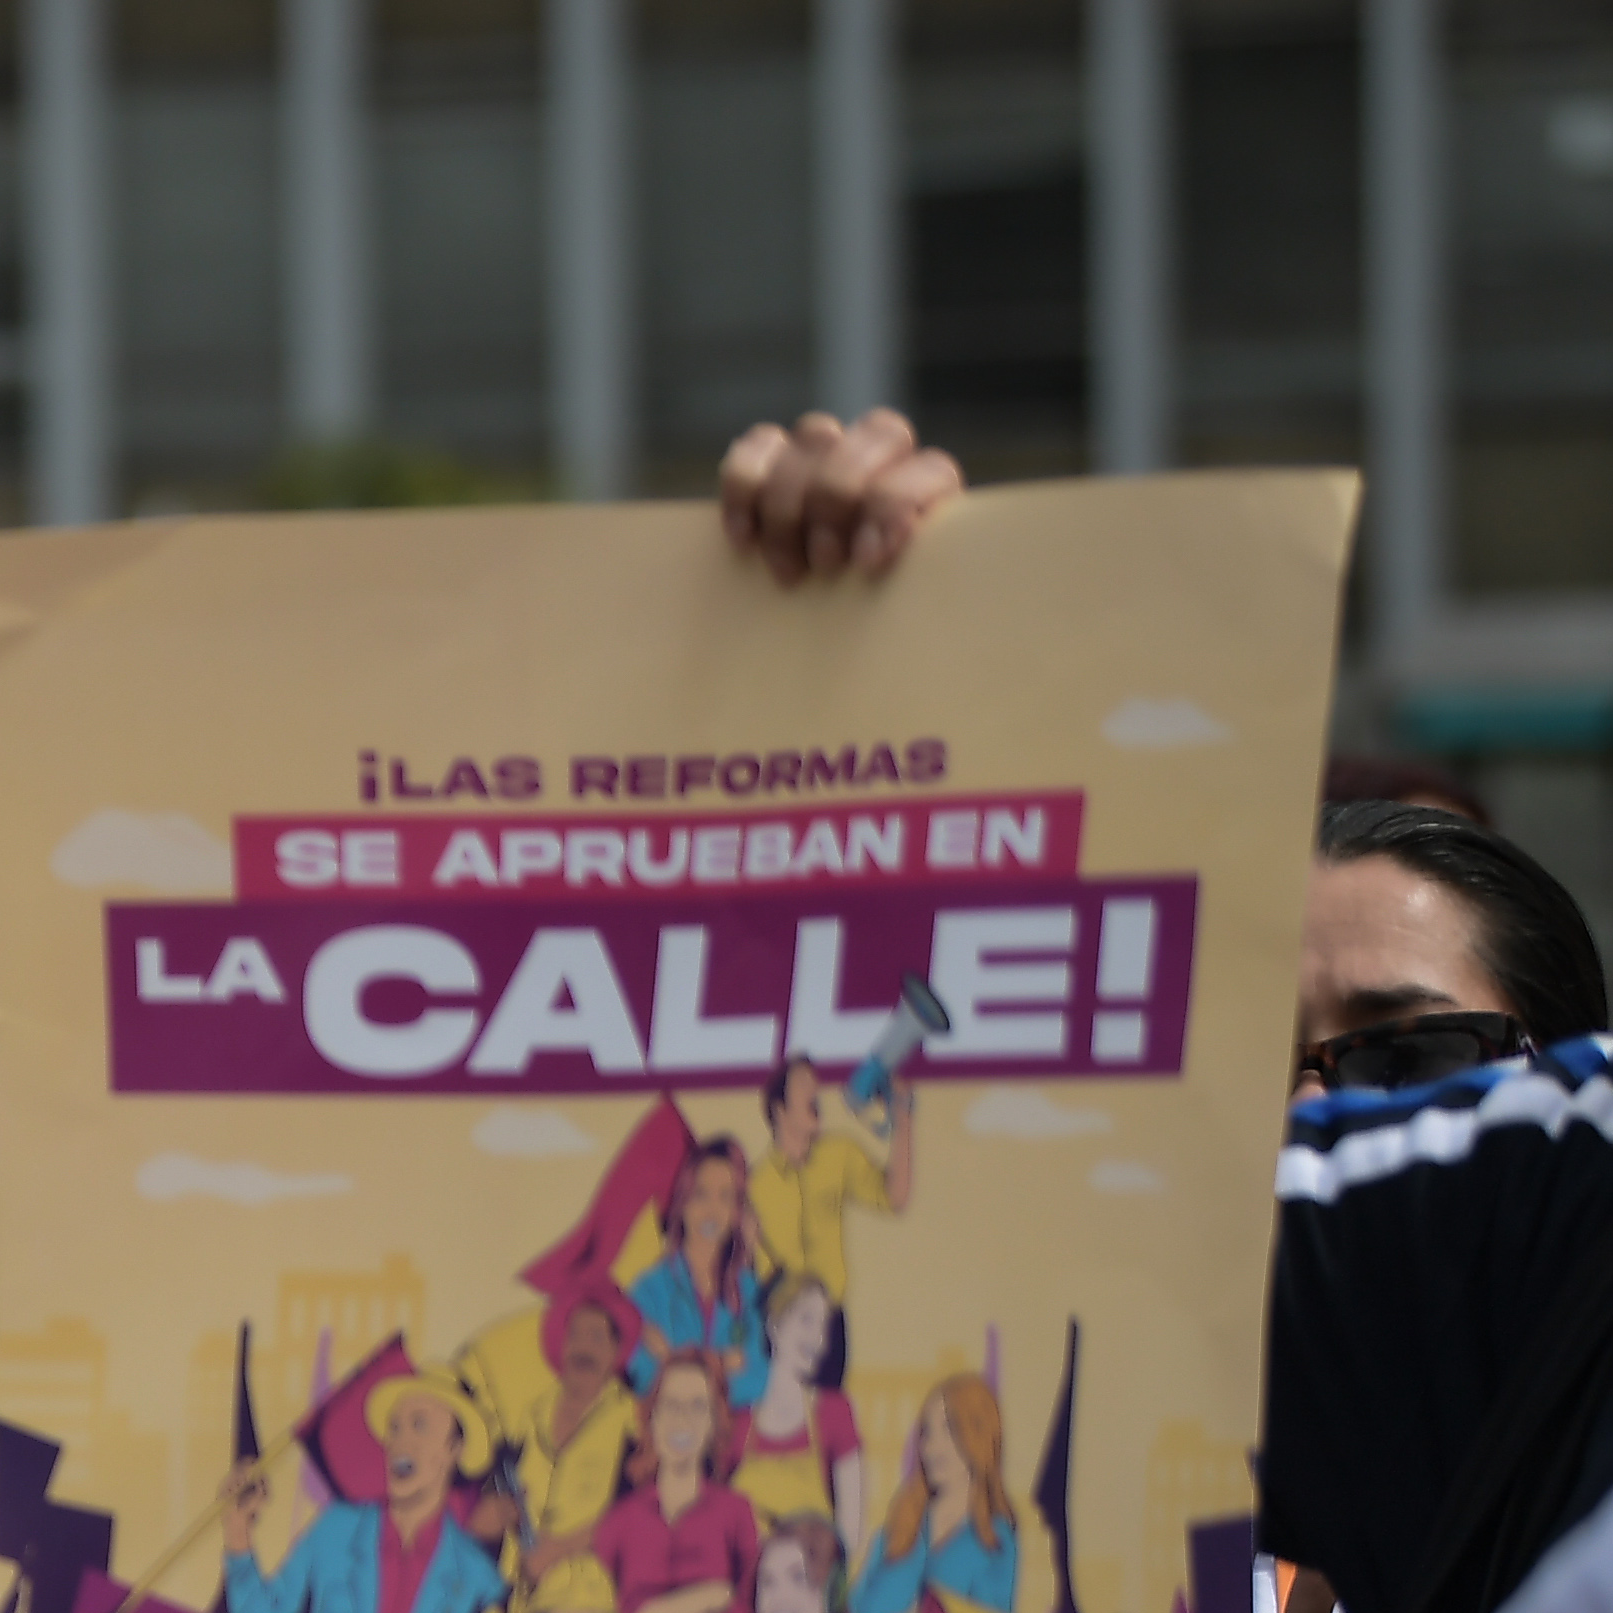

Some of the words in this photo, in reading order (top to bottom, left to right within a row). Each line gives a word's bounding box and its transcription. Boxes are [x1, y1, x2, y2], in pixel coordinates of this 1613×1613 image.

[569, 738, 948, 799] REFORMAS
[274, 828, 401, 889] SE
[431, 812, 903, 889] APRUEBAN
[923, 808, 1044, 872] EN
[135, 936, 285, 1003] LA
[300, 897, 1157, 1078] CALLE!
